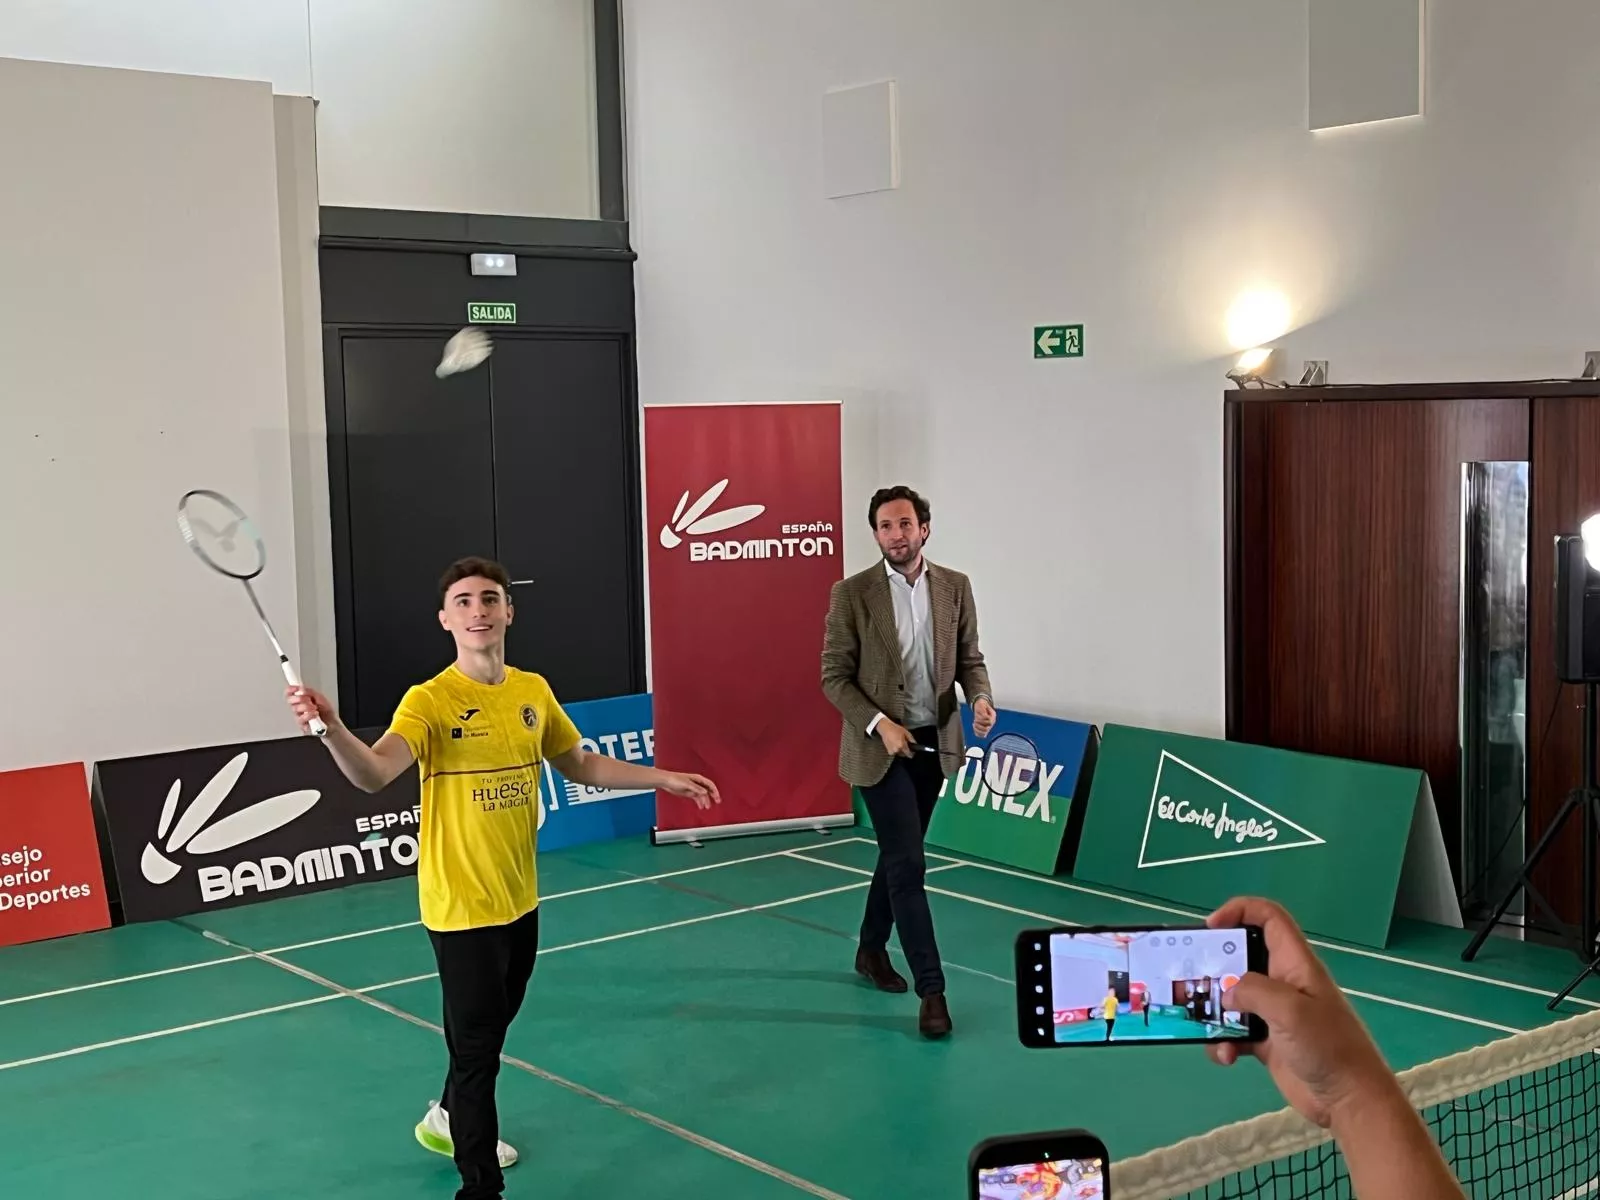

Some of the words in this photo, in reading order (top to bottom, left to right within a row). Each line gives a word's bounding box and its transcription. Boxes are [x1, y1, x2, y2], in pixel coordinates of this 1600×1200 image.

[472, 306, 512, 320] SALIDA
[782, 521, 833, 534] ESPAÑA
[689, 537, 834, 562] BADMINTON
[939, 745, 1064, 823] ONEX
[1158, 796, 1175, 820] El
[1175, 801, 1216, 829] Corte
[1214, 802, 1278, 843] Inglés
[0, 845, 42, 867] sejo
[198, 832, 420, 902] BADMINTO
[0, 884, 91, 911] Deportes
